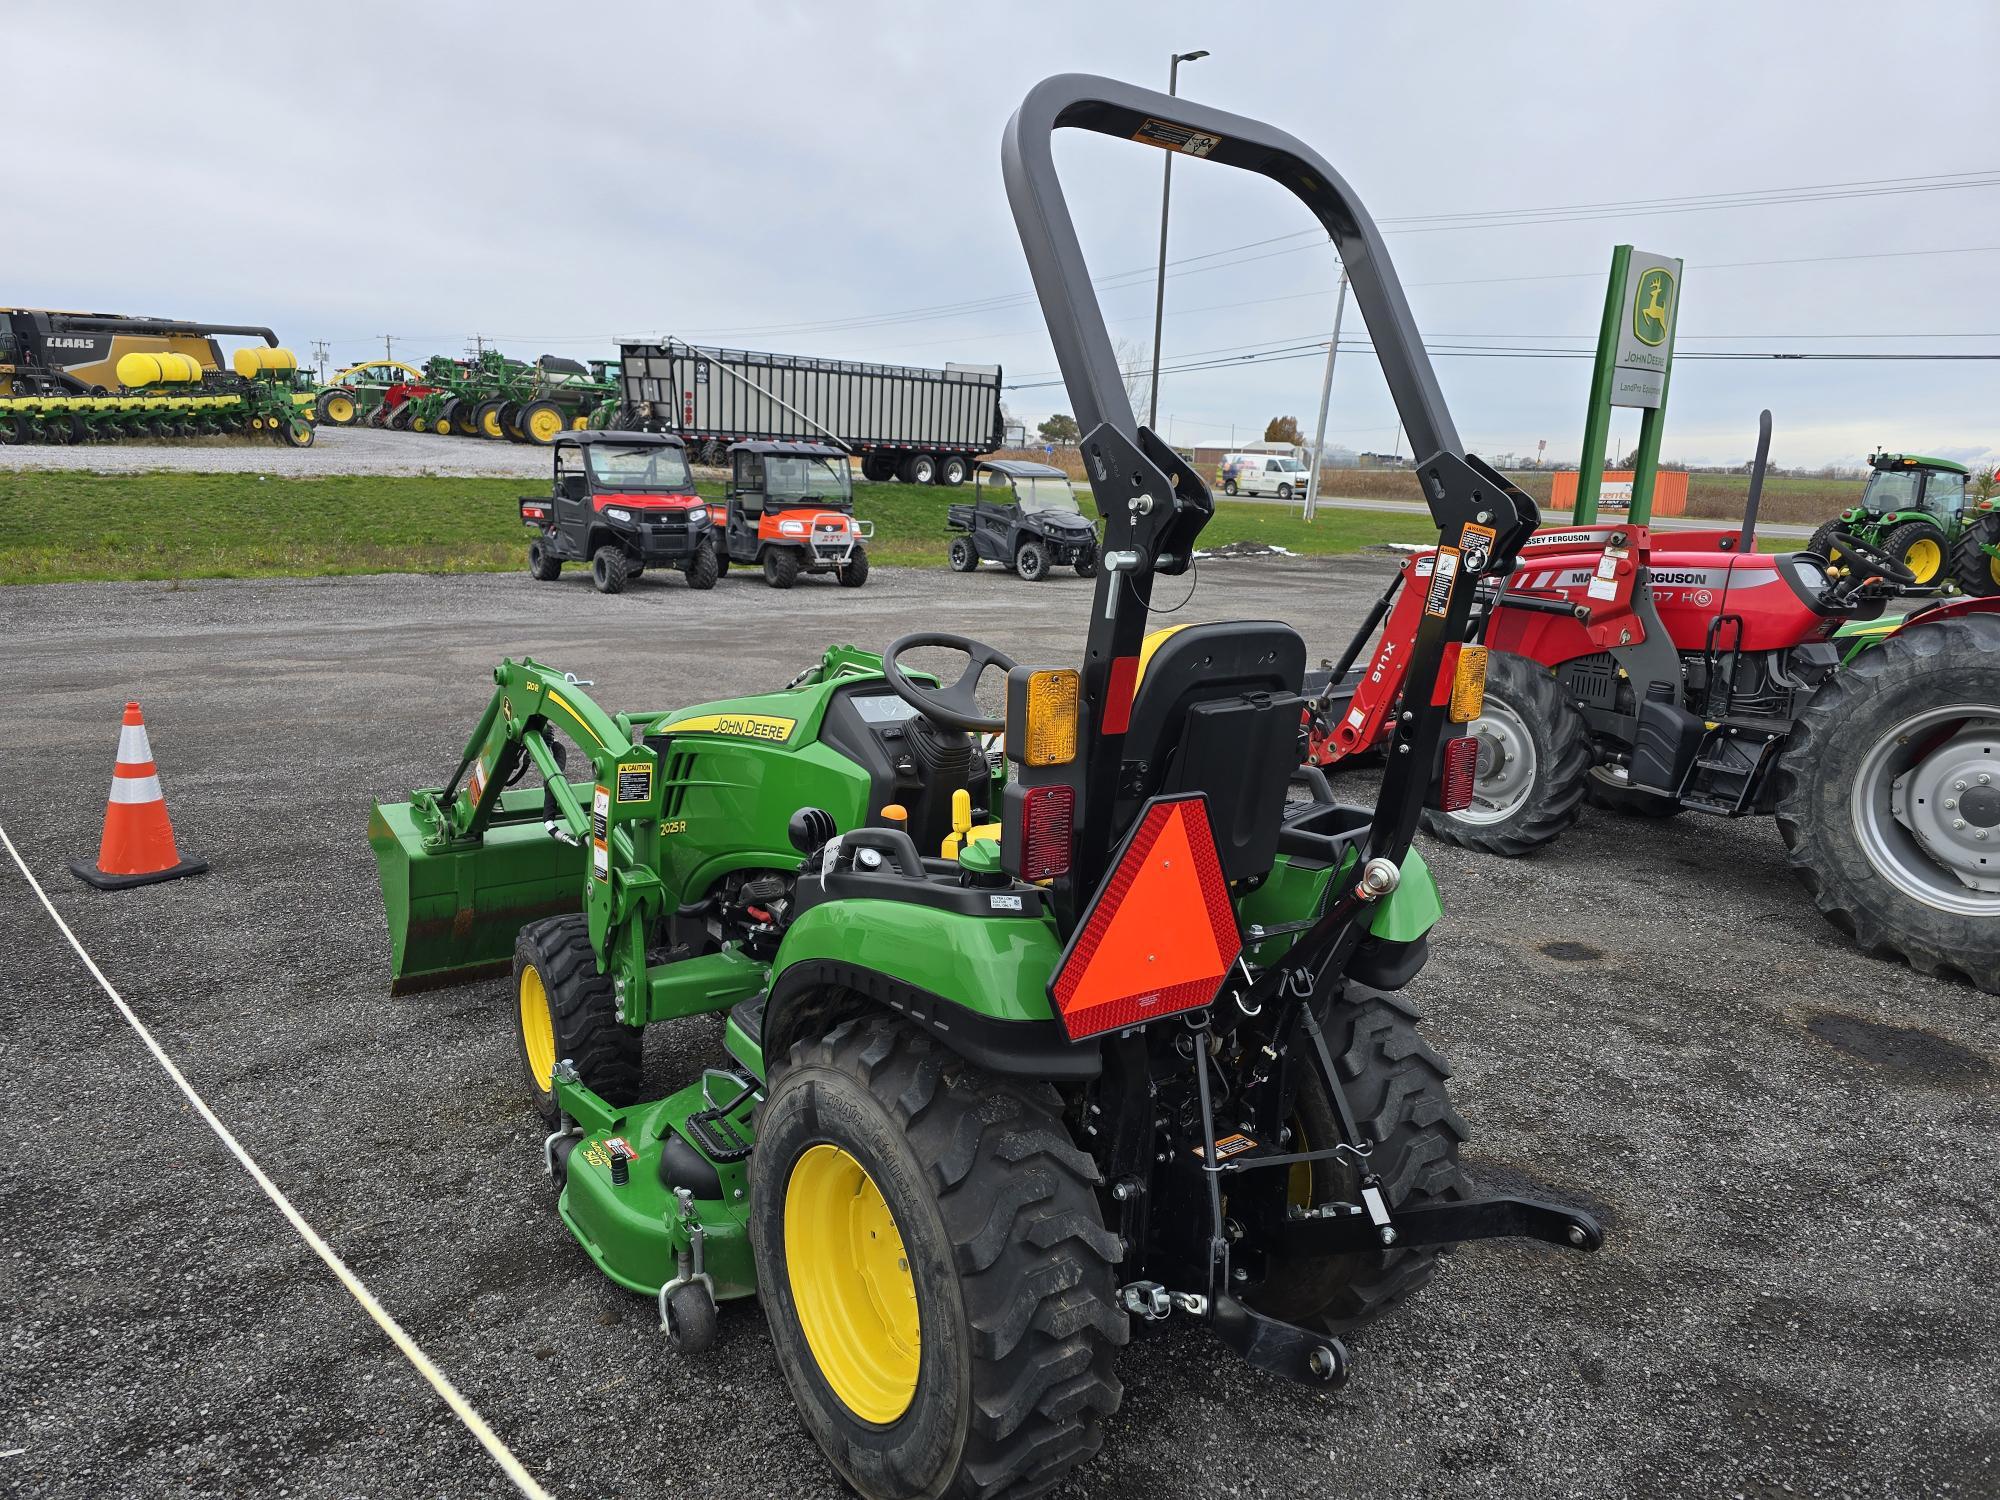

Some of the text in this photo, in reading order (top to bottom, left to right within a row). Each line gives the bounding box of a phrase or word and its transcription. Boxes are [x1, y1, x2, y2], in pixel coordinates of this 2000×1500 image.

[47, 337, 94, 349] CLAAS
[1624, 351, 1665, 367] JOHN DEERE
[1620, 382, 1642, 393] LandPro
[1526, 534, 1590, 545] SSEY FERGUSON
[1371, 641, 1396, 683] 911X
[713, 717, 785, 739] JOHN DEERE
[627, 763, 651, 772] CAUTION
[824, 1092, 863, 1127] TRAC
